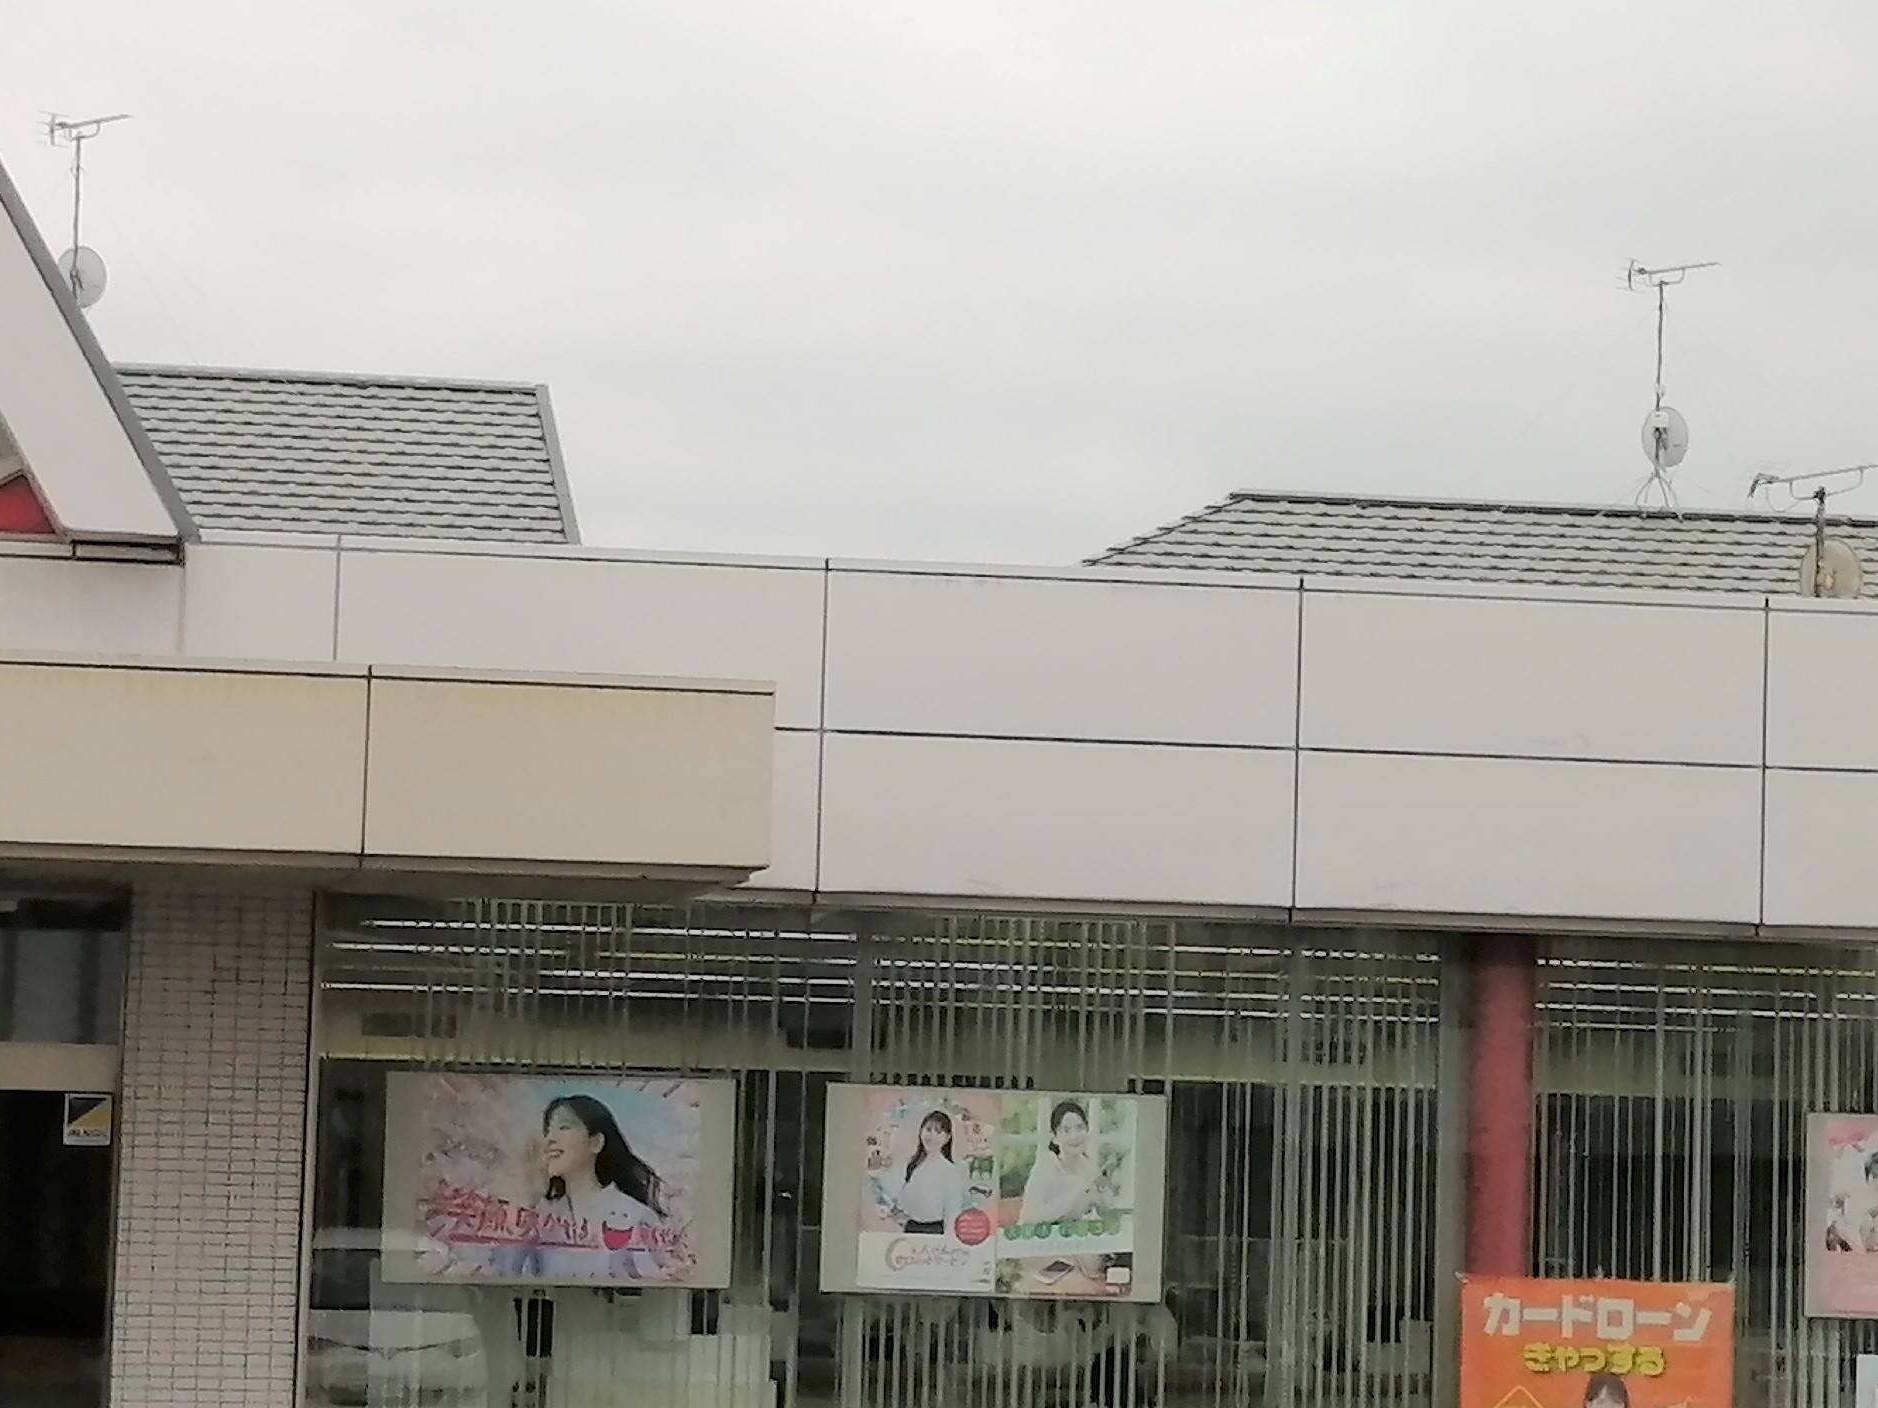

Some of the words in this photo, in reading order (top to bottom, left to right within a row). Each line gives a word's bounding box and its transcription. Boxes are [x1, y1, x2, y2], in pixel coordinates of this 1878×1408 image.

[1482, 1292, 1712, 1342] カードローン
